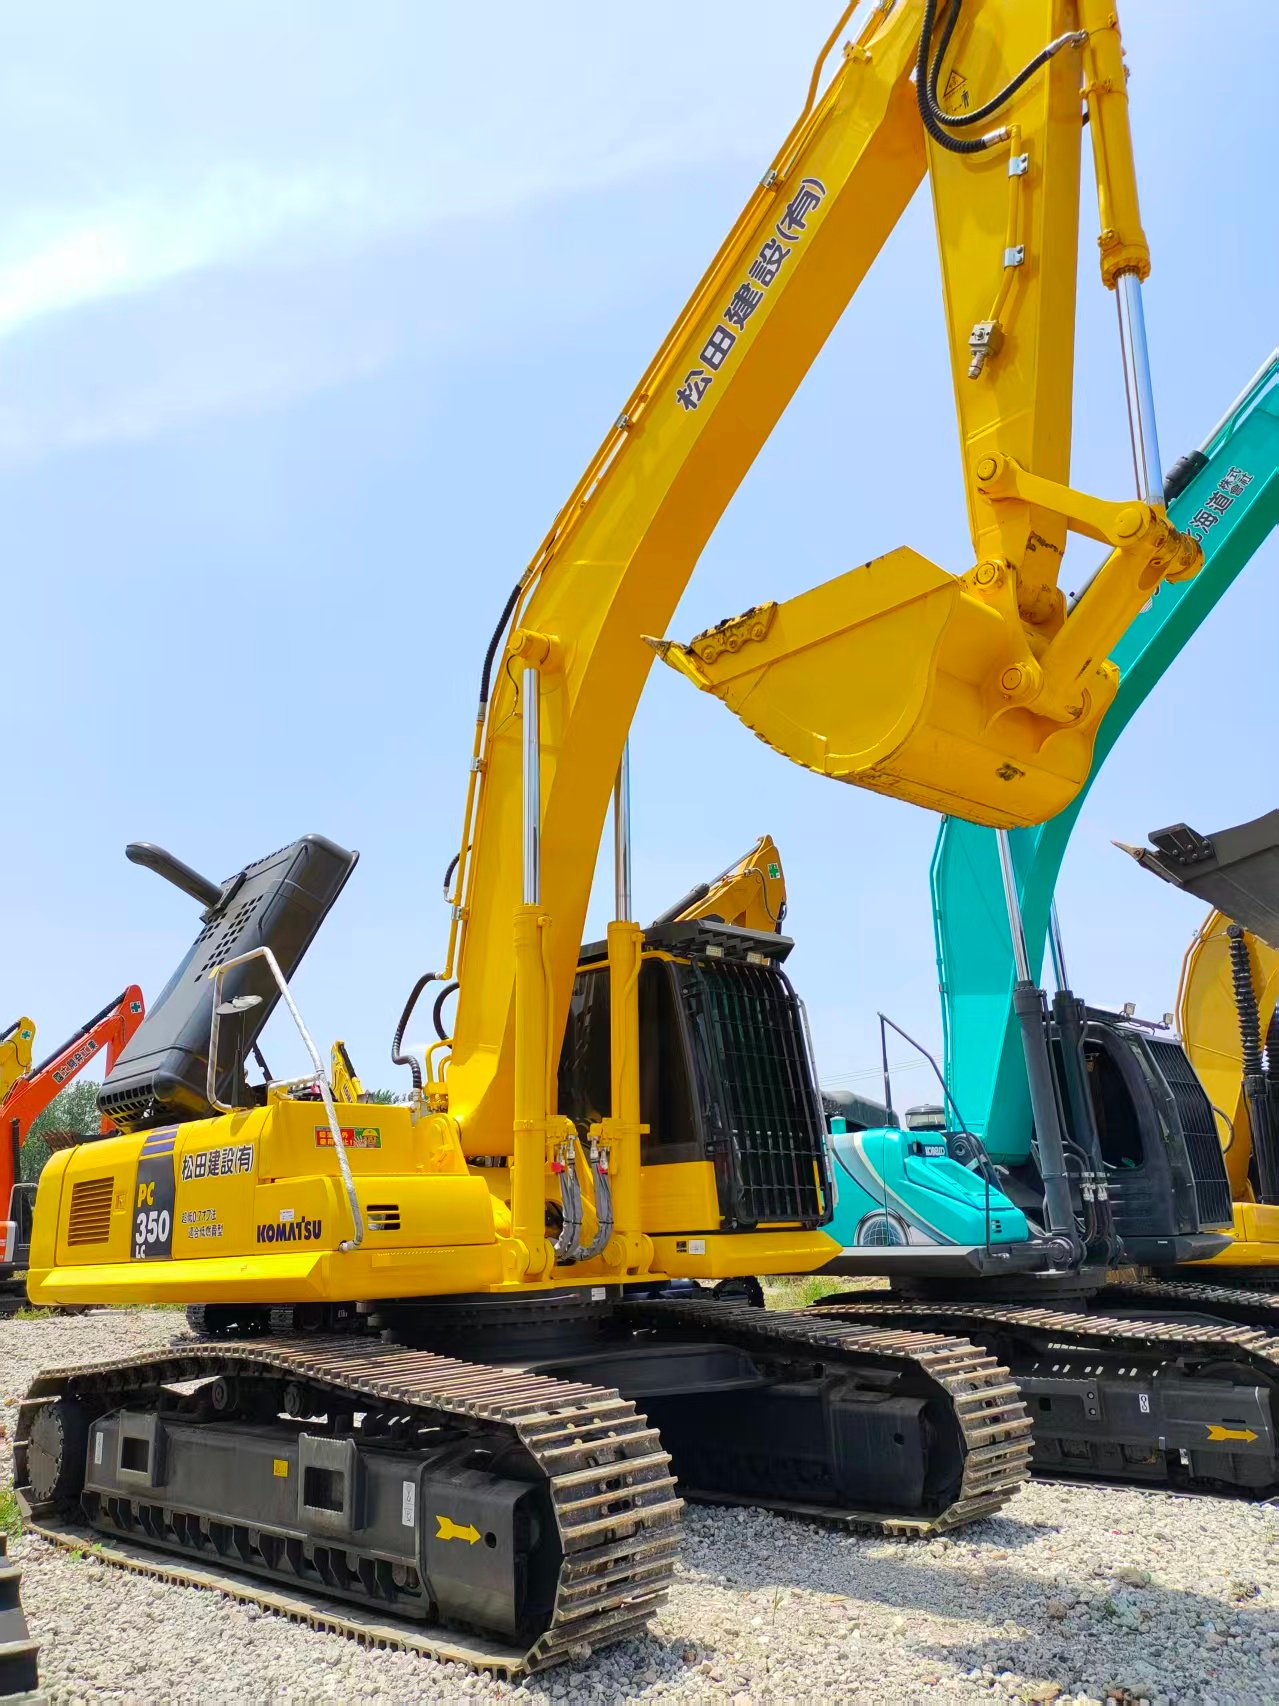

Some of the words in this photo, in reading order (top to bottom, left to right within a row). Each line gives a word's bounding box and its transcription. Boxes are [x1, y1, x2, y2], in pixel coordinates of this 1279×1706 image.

[676, 178, 827, 411] 松田建設(有)
[182, 1143, 255, 1181] 松田建設(有)
[137, 1182, 155, 1207] PC
[135, 1210, 170, 1244] 350
[257, 1216, 322, 1243] KOMATSU
[135, 1245, 146, 1259] LC
